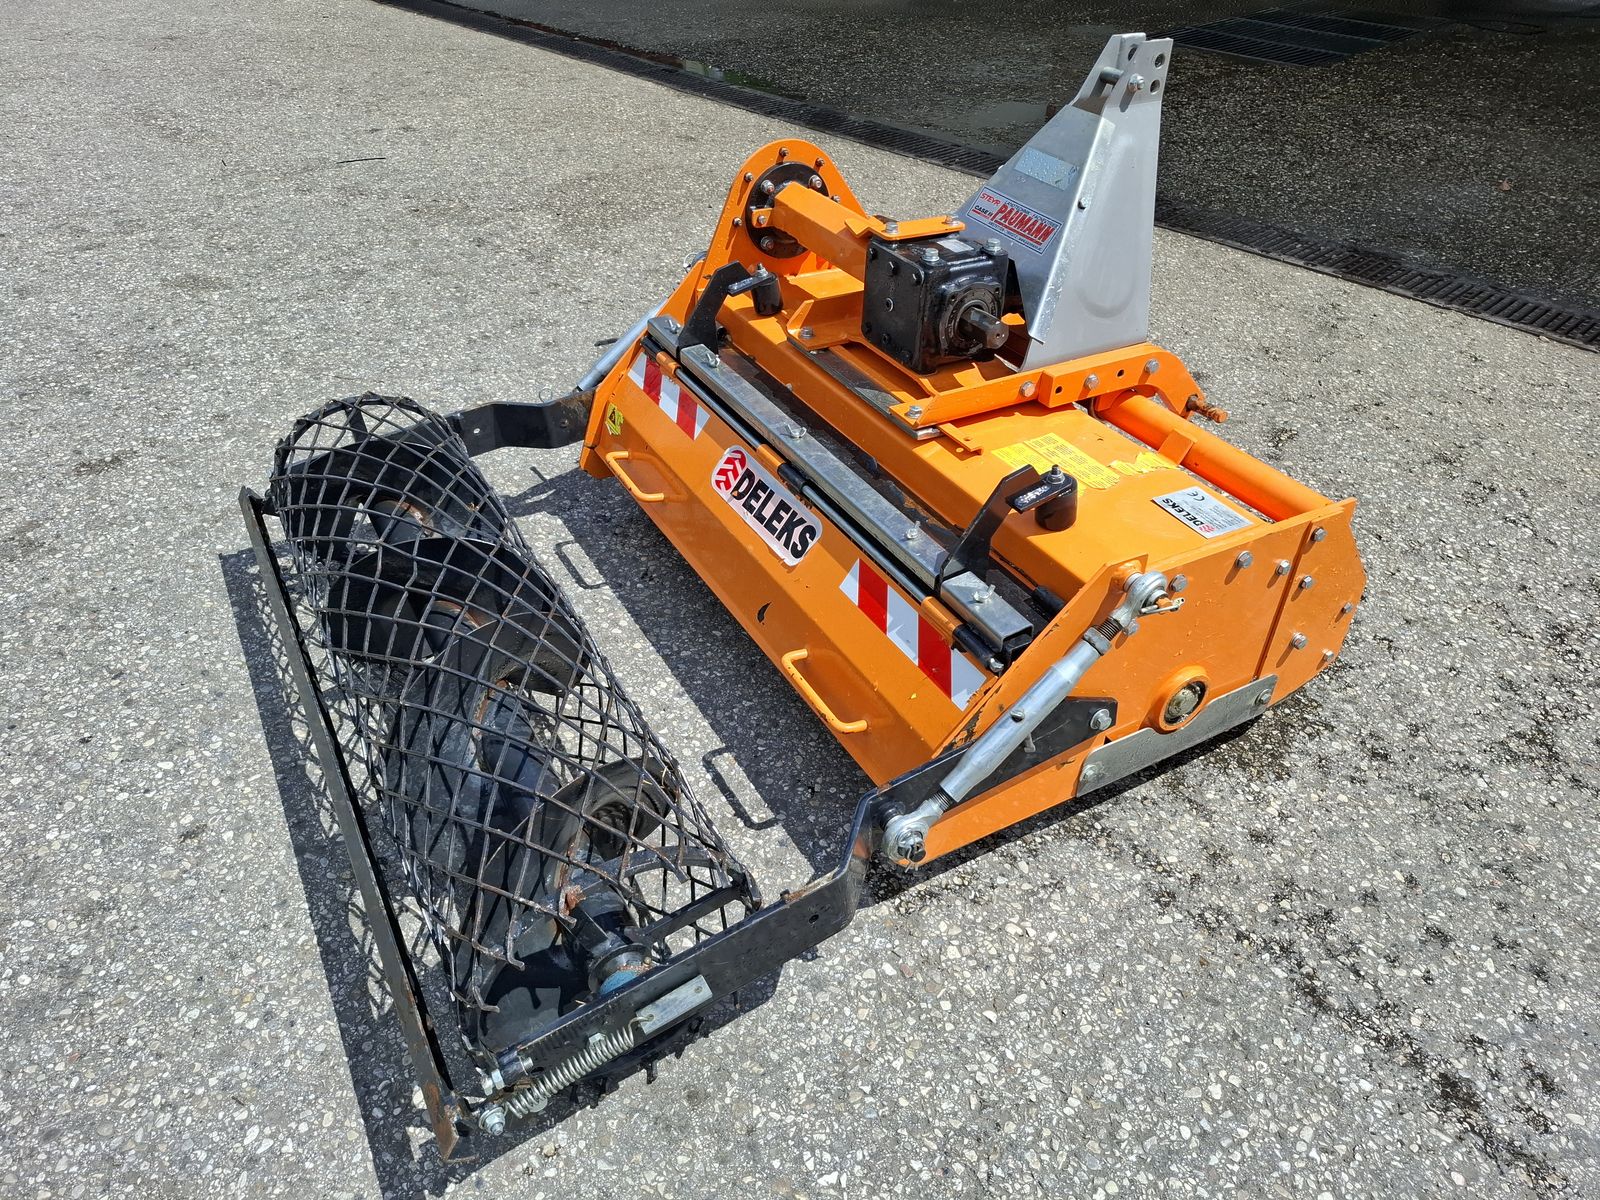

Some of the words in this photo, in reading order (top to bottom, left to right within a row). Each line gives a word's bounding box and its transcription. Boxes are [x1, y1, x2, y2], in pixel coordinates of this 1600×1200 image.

[974, 204, 989, 214] CASE
[980, 192, 1001, 206] STEYR
[991, 204, 1055, 242] PAUMANN
[730, 467, 817, 559] DELEKS
[1162, 497, 1204, 526] DELEKS
